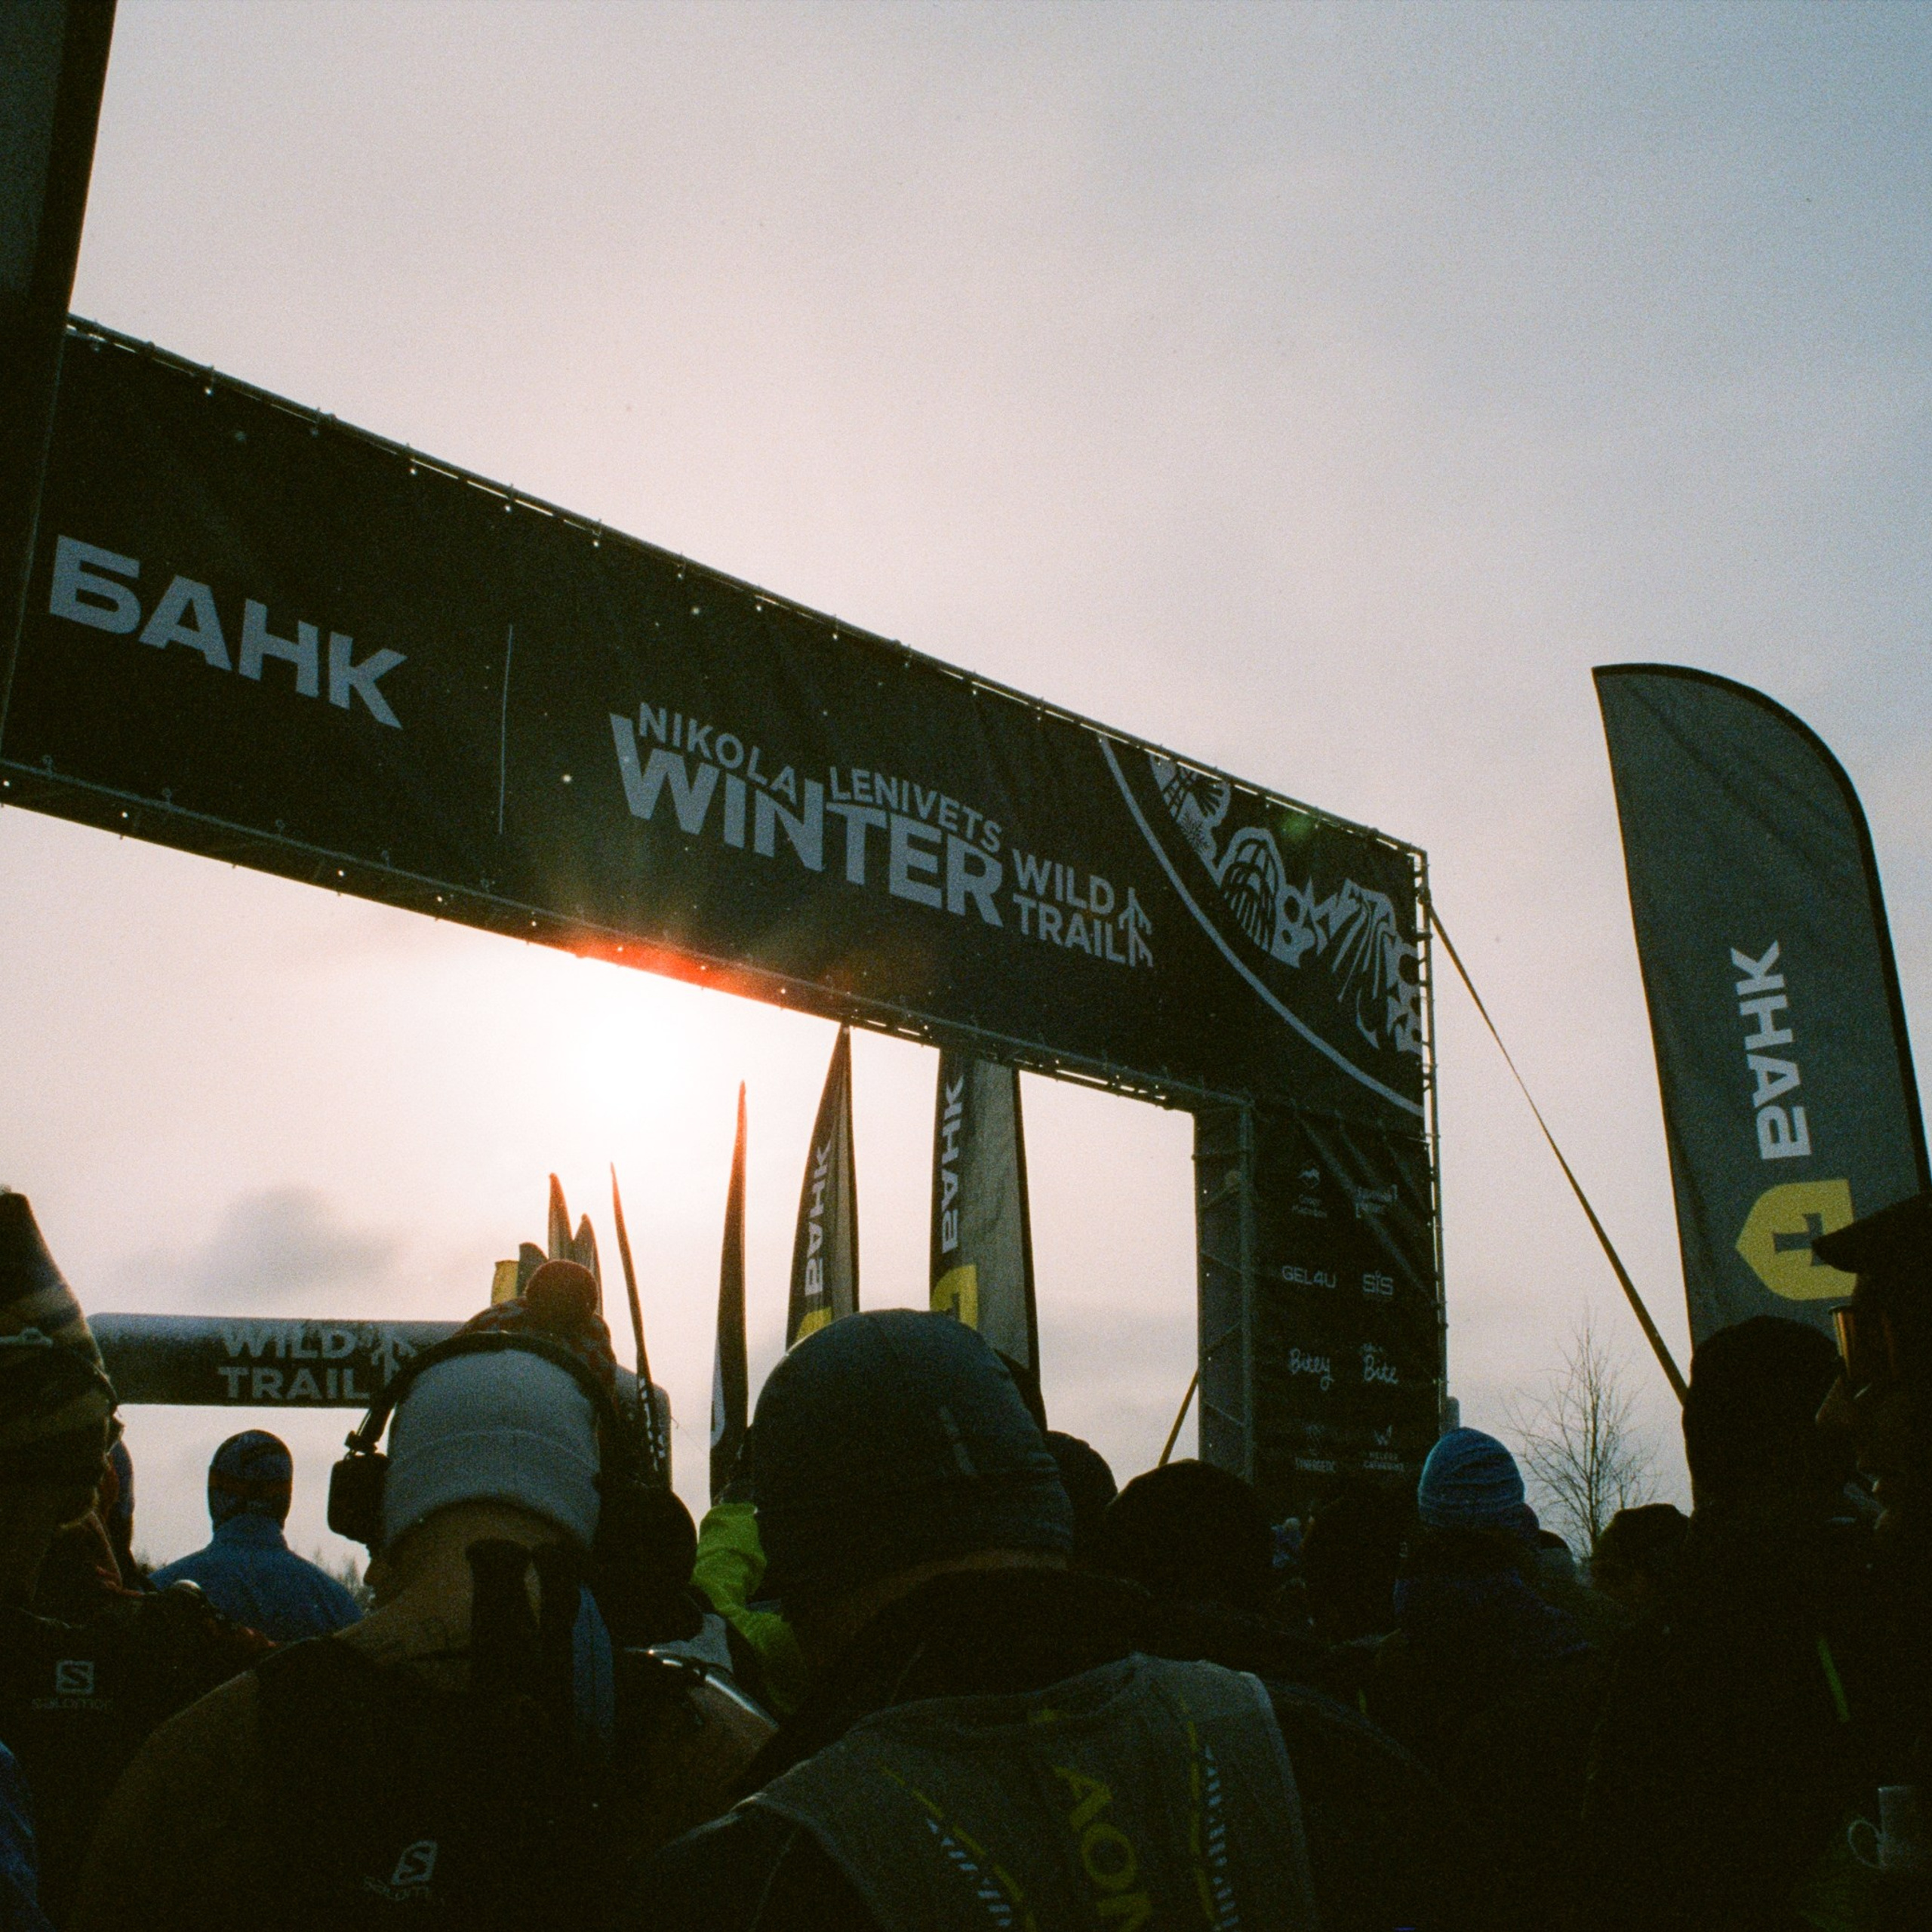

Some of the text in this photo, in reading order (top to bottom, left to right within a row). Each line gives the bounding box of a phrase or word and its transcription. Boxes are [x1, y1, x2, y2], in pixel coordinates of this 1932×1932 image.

[49, 534, 407, 729] БАНК
[638, 702, 1002, 852] NIKOLA LENIVETS
[609, 713, 1004, 928] WINTER
[1011, 848, 1115, 912] WILD
[1012, 894, 1130, 968] TRAIL
[1281, 1266, 1338, 1289] GEL4U
[223, 1323, 358, 1359] WILD
[217, 1367, 371, 1400] TRAIL
